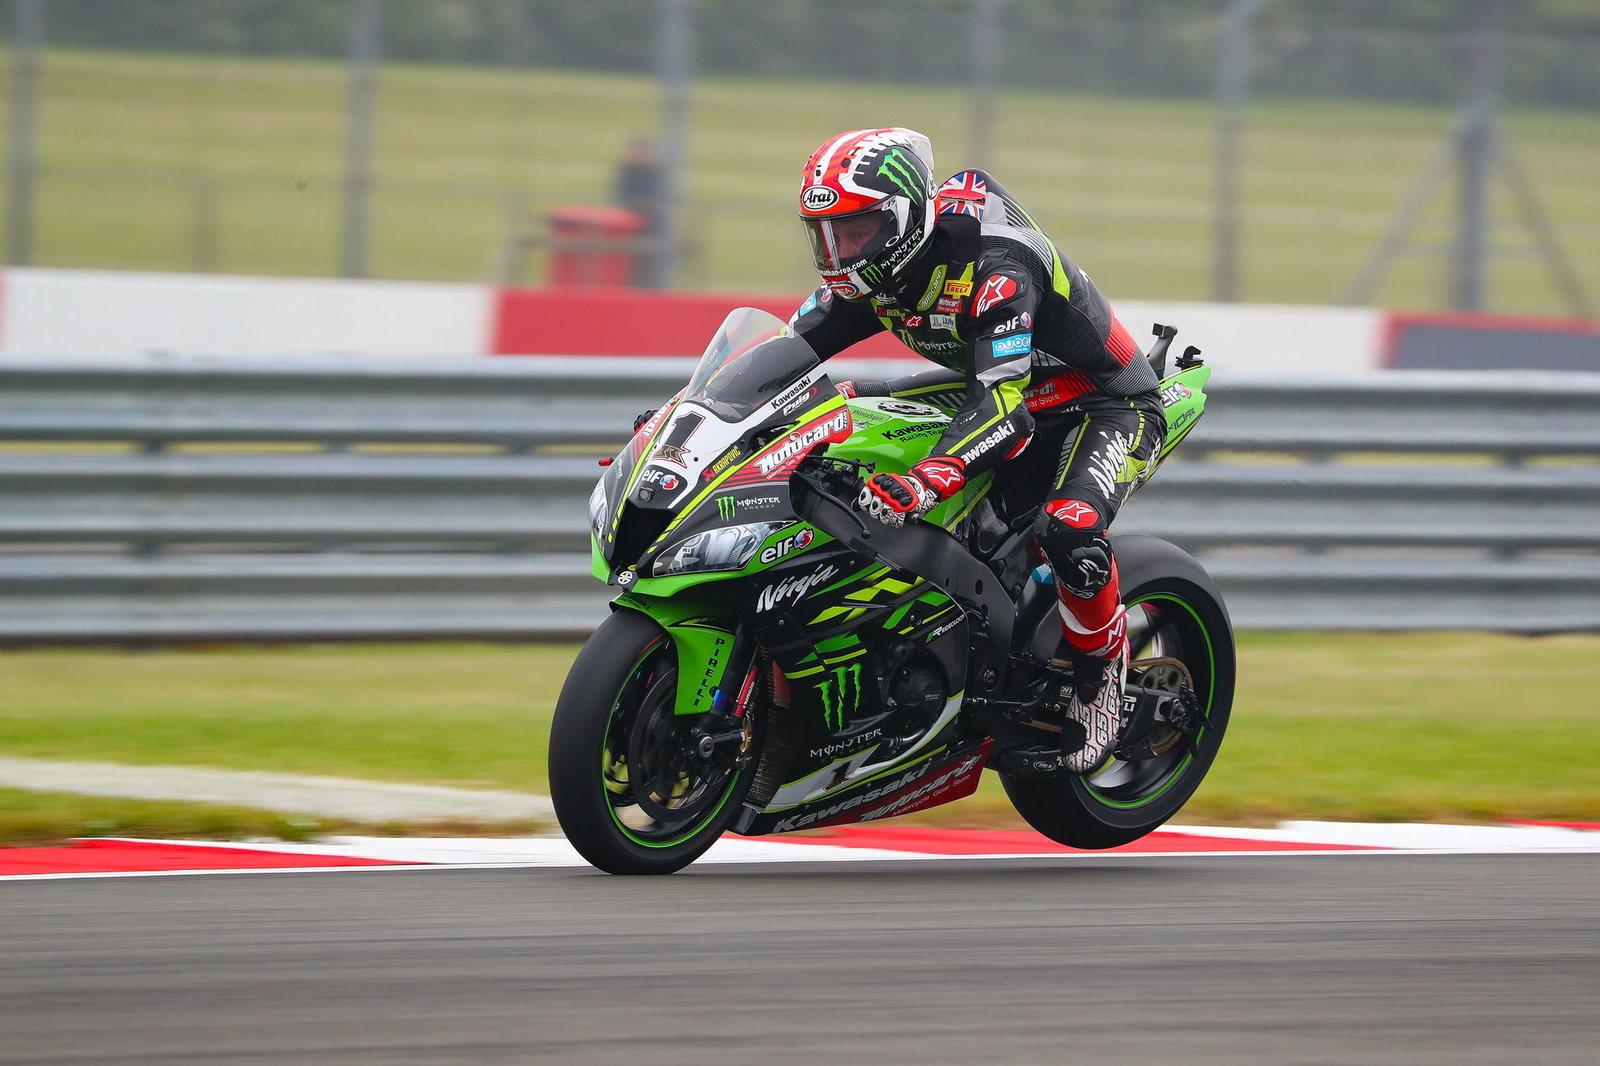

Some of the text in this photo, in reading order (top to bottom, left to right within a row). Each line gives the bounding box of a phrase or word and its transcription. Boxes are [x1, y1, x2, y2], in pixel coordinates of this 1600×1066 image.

[803, 190, 832, 204] Arai
[880, 227, 922, 269] MONSTER
[994, 315, 1020, 334] elf
[771, 375, 811, 410] Kawasaki
[1039, 393, 1061, 405] Store
[753, 411, 845, 476] Motocard
[961, 420, 1016, 465] awasaki
[641, 470, 664, 483] elf
[736, 496, 781, 507] MONSTER
[760, 534, 795, 565] elf
[755, 563, 840, 614] Ninja
[693, 637, 726, 707] PIRELLI
[809, 728, 883, 758] MONSTER
[772, 758, 934, 833] Kawasaki
[933, 785, 950, 797] Gear
[953, 774, 971, 787] Store
